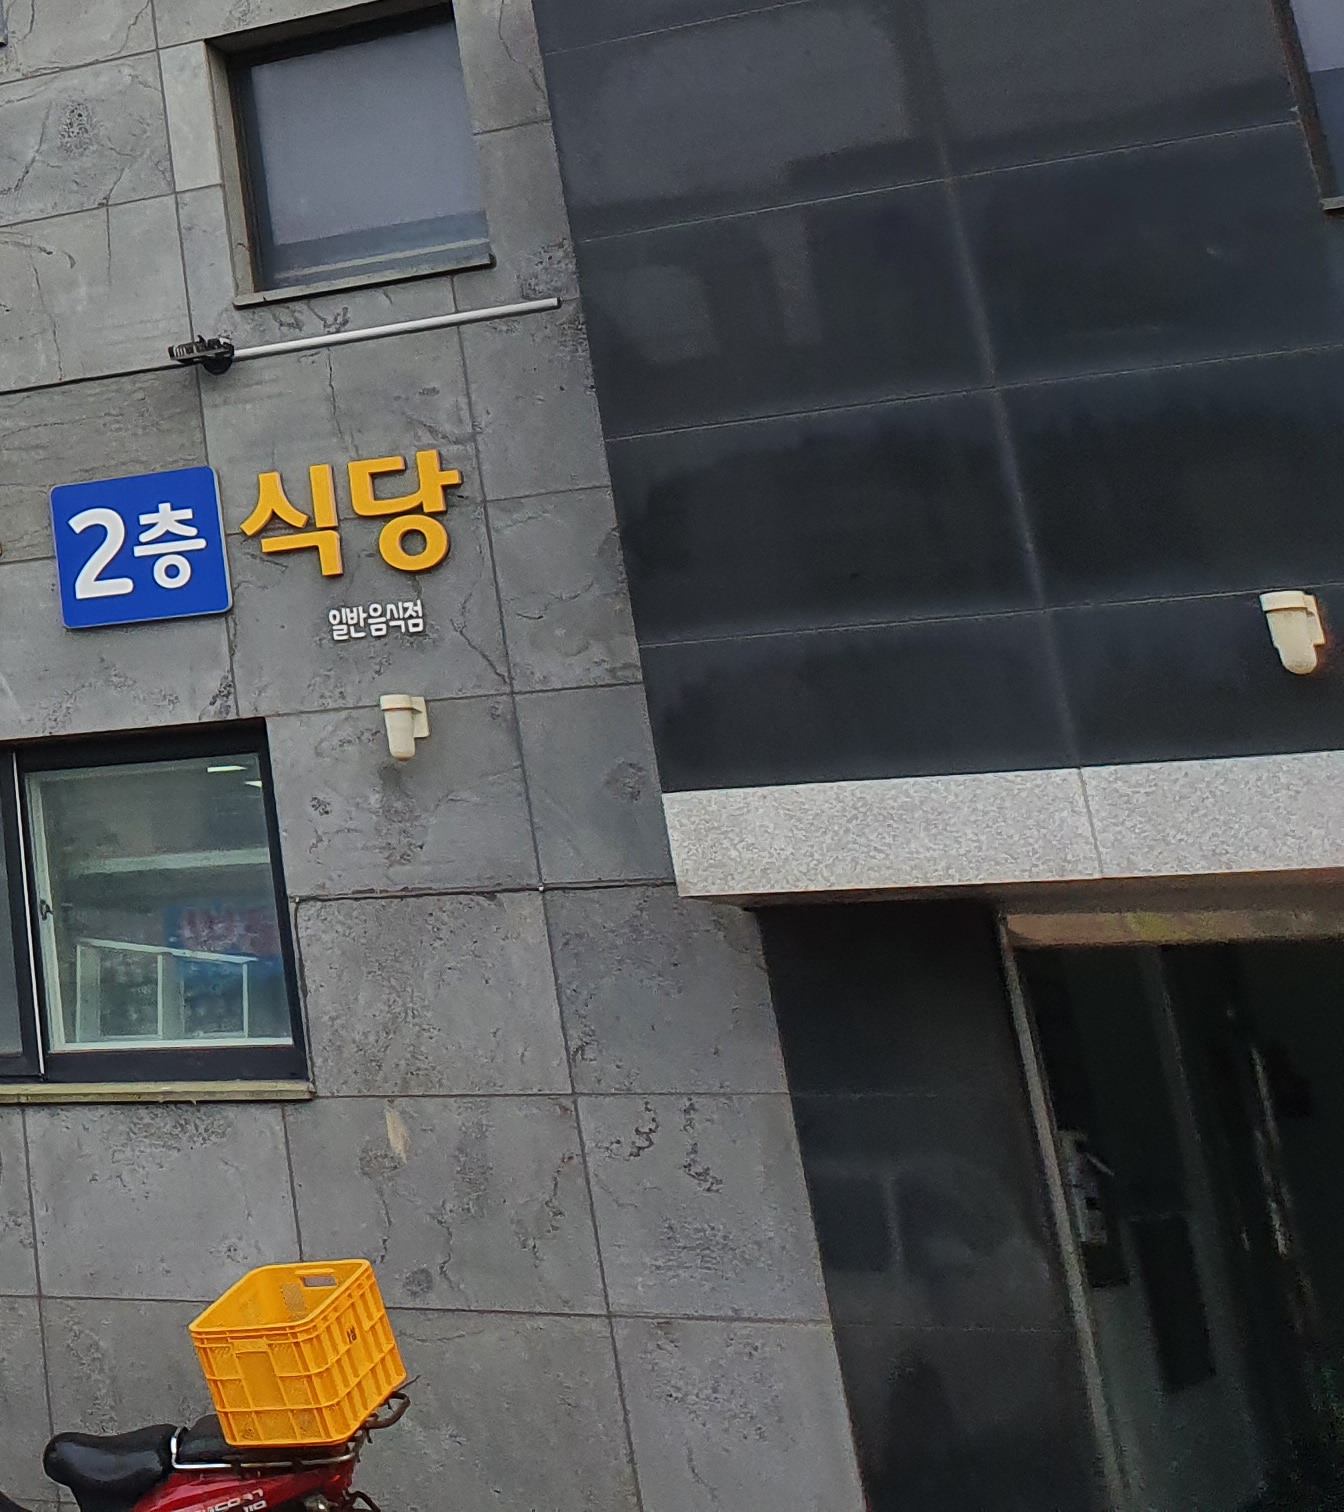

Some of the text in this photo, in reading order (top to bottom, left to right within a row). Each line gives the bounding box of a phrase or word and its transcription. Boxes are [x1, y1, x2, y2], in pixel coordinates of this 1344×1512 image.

[67, 449, 462, 601] 2층 식당
[328, 599, 424, 641] 일반음식점
